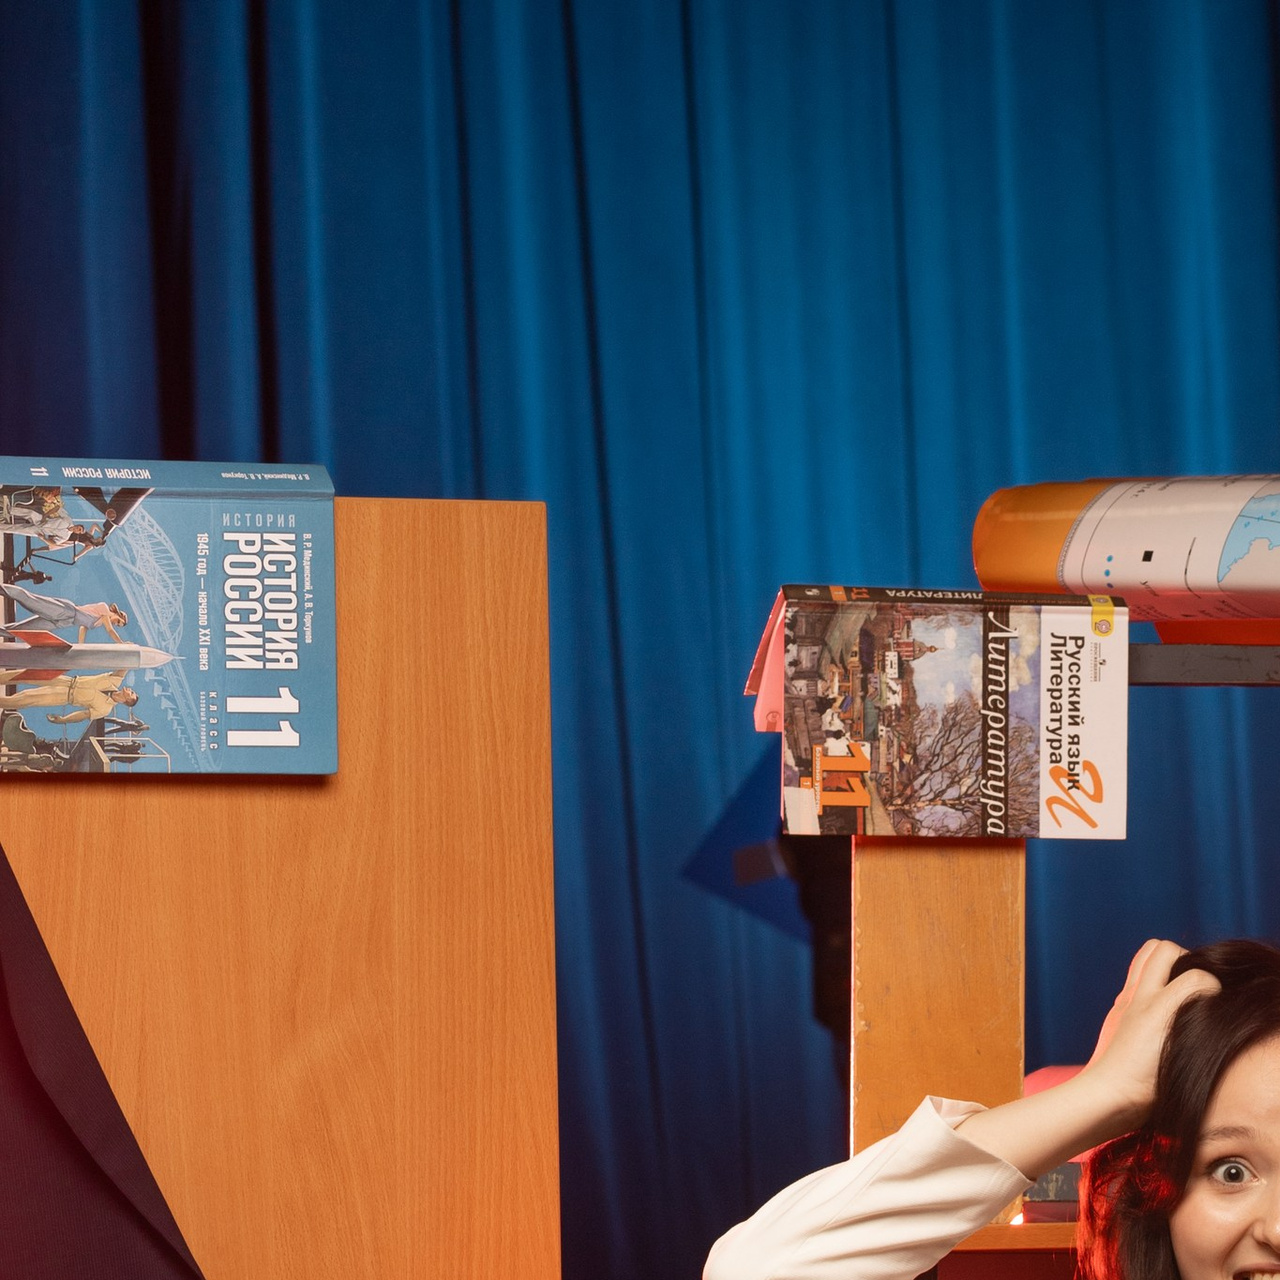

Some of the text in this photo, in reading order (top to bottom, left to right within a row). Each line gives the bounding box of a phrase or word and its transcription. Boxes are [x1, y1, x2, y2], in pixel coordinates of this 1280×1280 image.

[30, 466, 49, 477] 11
[62, 466, 151, 480] ИСТОРИЯ РОССИИ
[222, 512, 296, 528] ИСТОРИЯ
[197, 532, 209, 555] 1945
[195, 557, 208, 576] год
[222, 532, 264, 669] РОССИИ
[262, 532, 299, 671] ИСТОРИЯ
[302, 532, 314, 644] В. Р. Мединский, А. В. Торкунов
[851, 587, 871, 600] 11
[885, 588, 983, 601] ЛИТЕРАТУРА
[197, 591, 209, 626] начало
[198, 627, 211, 646] XXI
[198, 647, 210, 671] века
[1045, 632, 1064, 765] Литература
[1063, 634, 1086, 791] Русский язык
[208, 691, 219, 750] класс
[226, 686, 300, 747] 11
[980, 611, 1019, 835] Литература
[821, 743, 871, 806] 11
